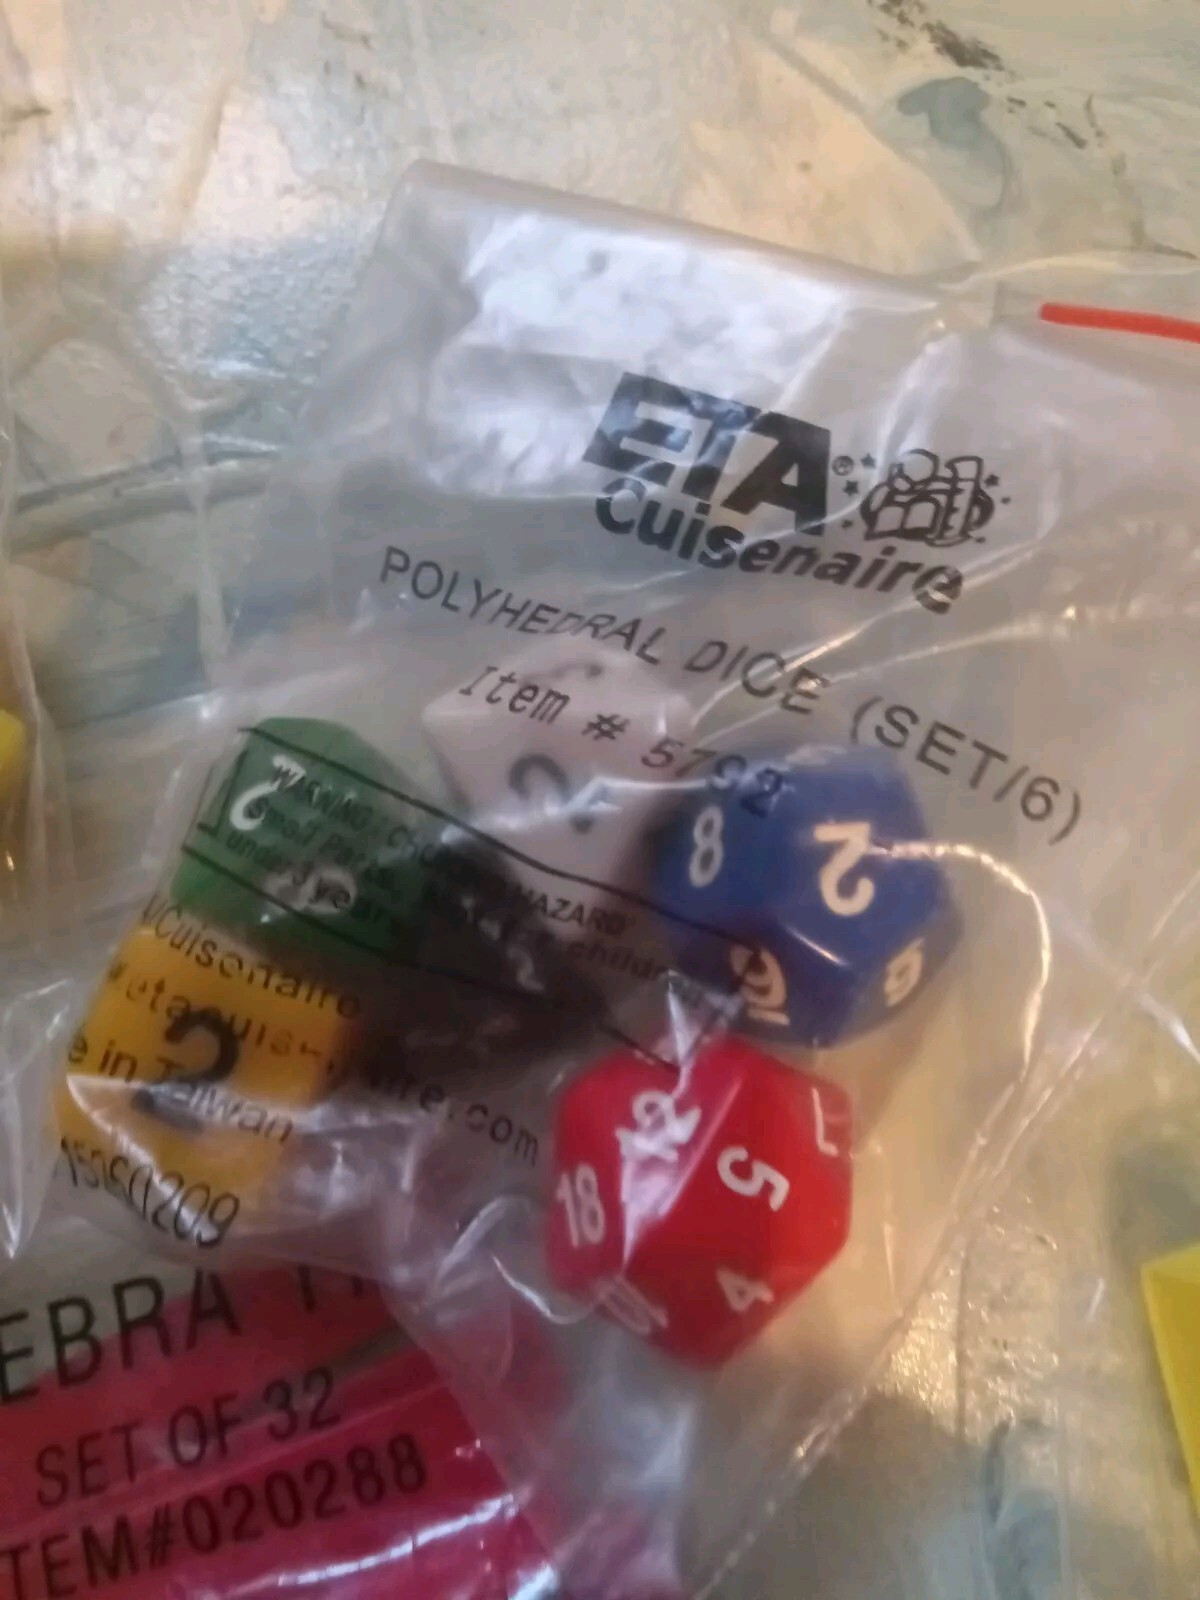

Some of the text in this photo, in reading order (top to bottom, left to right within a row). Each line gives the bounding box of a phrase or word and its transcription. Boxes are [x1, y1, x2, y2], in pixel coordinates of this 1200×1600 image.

[583, 371, 831, 536] ETA
[596, 478, 963, 615] Cuisenaire
[380, 546, 1082, 841] POLYHEDRAL DICE (SET/6)
[458, 666, 571, 725] Item
[689, 805, 724, 888] 8
[813, 821, 875, 917] 2
[99, 1039, 138, 1083] in
[35, 1365, 341, 1508] SET OF 32
